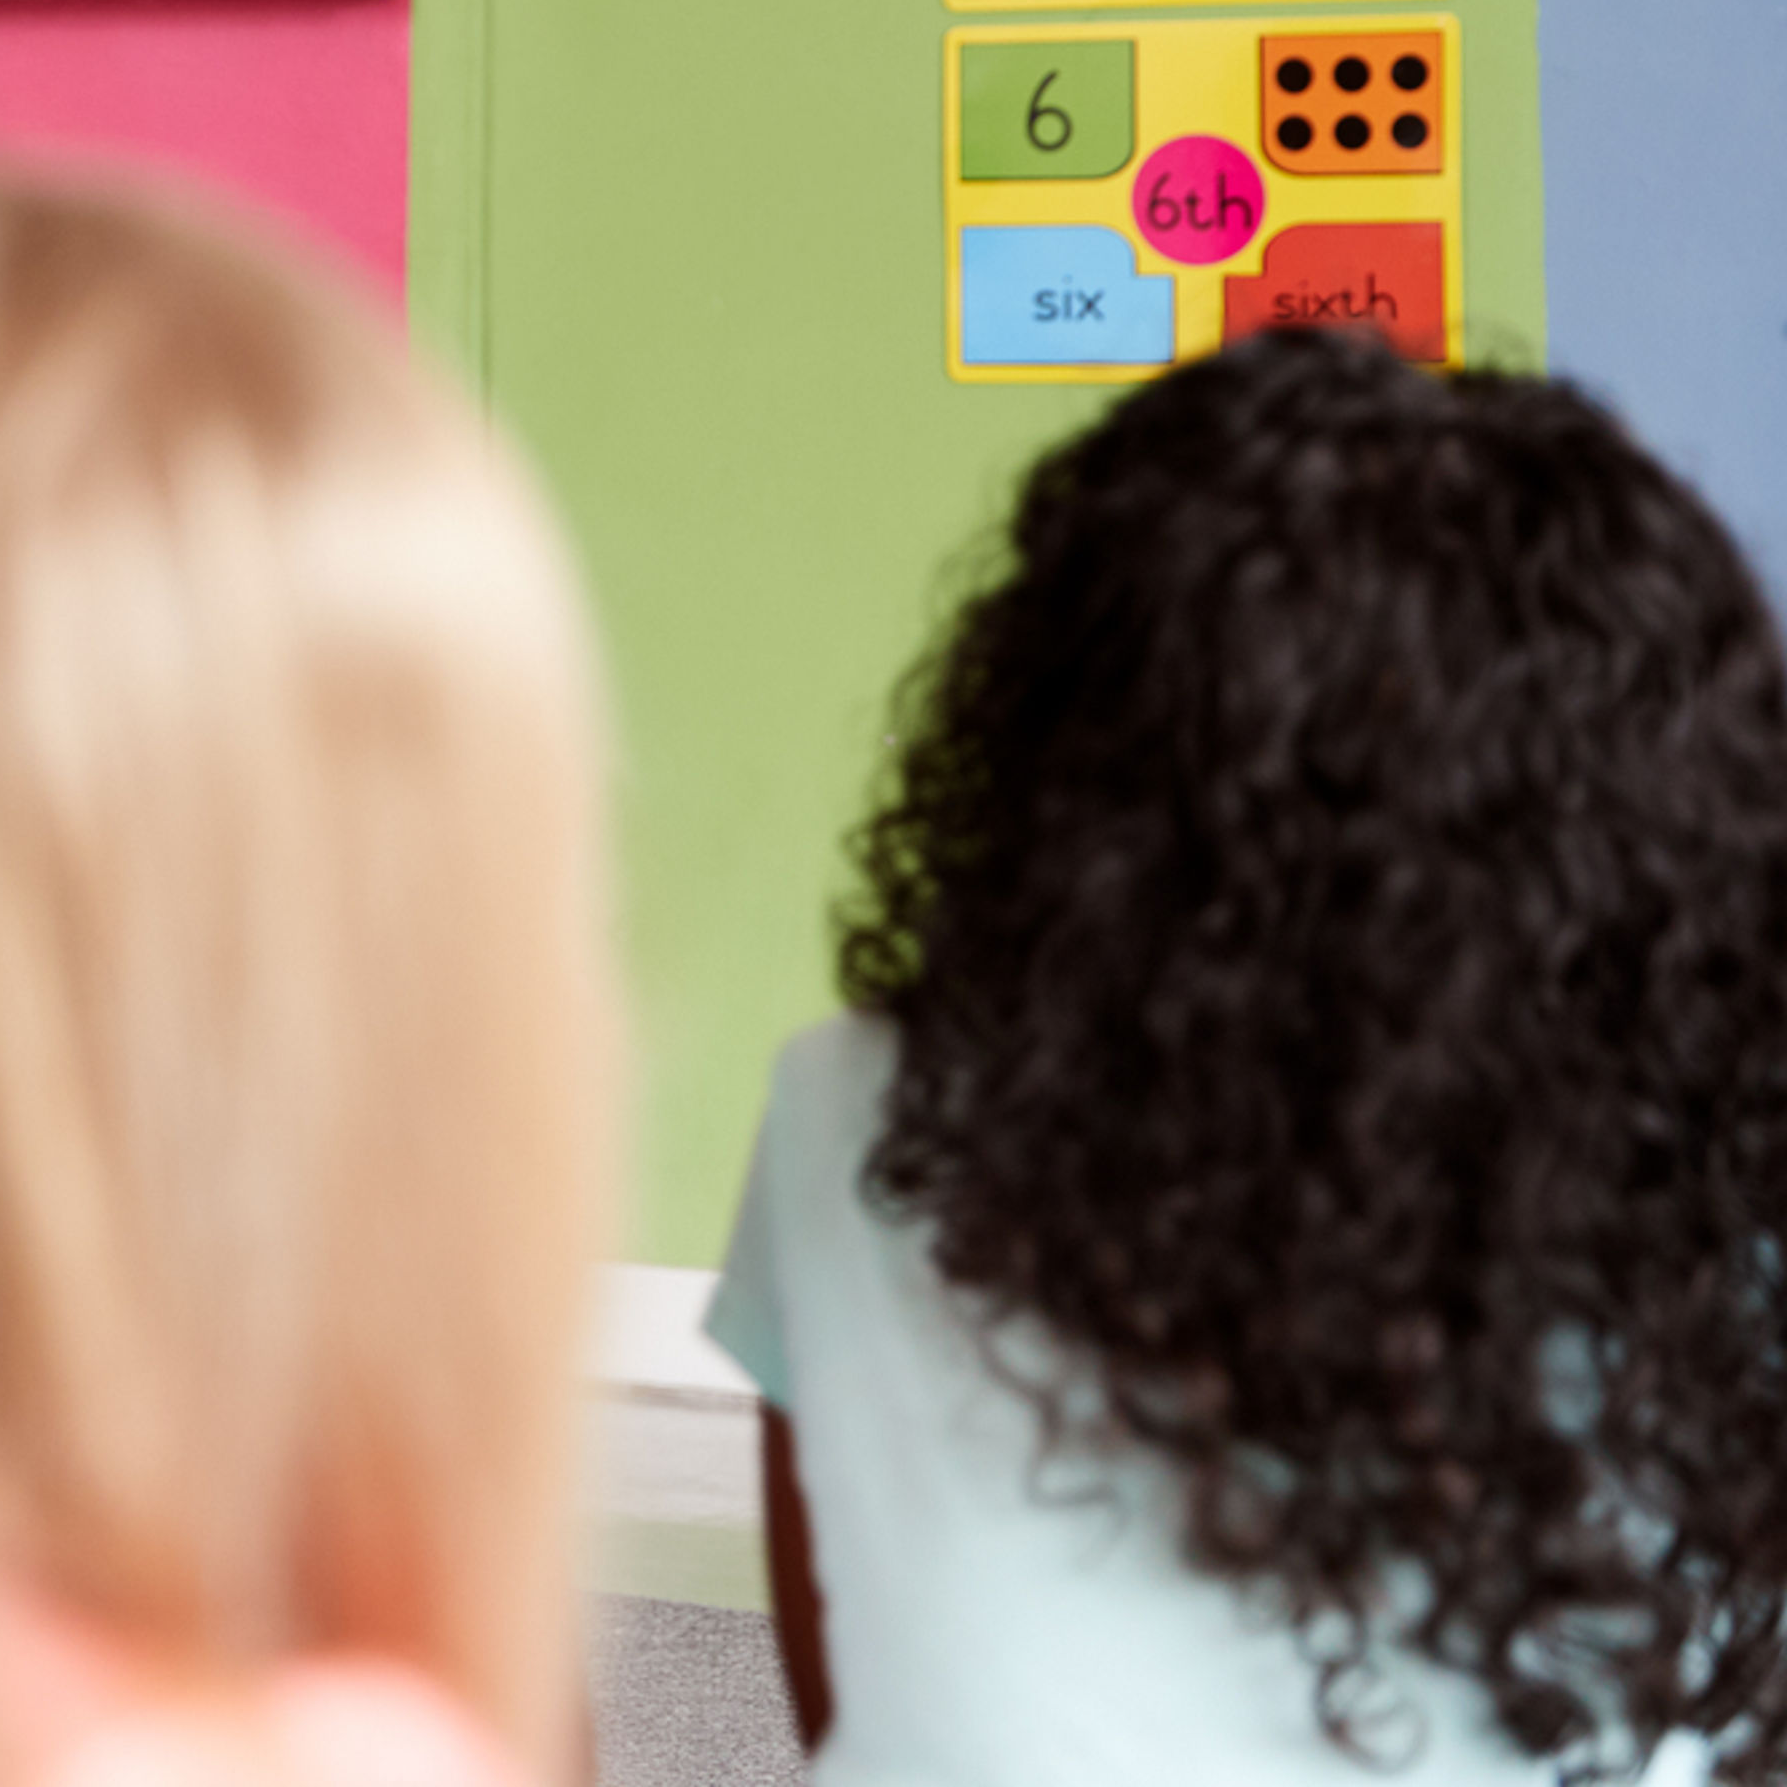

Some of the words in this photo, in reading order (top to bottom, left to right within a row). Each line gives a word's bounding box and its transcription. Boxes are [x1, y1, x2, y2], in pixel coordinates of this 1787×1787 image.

[1026, 67, 1073, 154] 6
[1146, 170, 1254, 232] 6th
[1032, 273, 1107, 324] six
[1273, 271, 1400, 322] sixth
